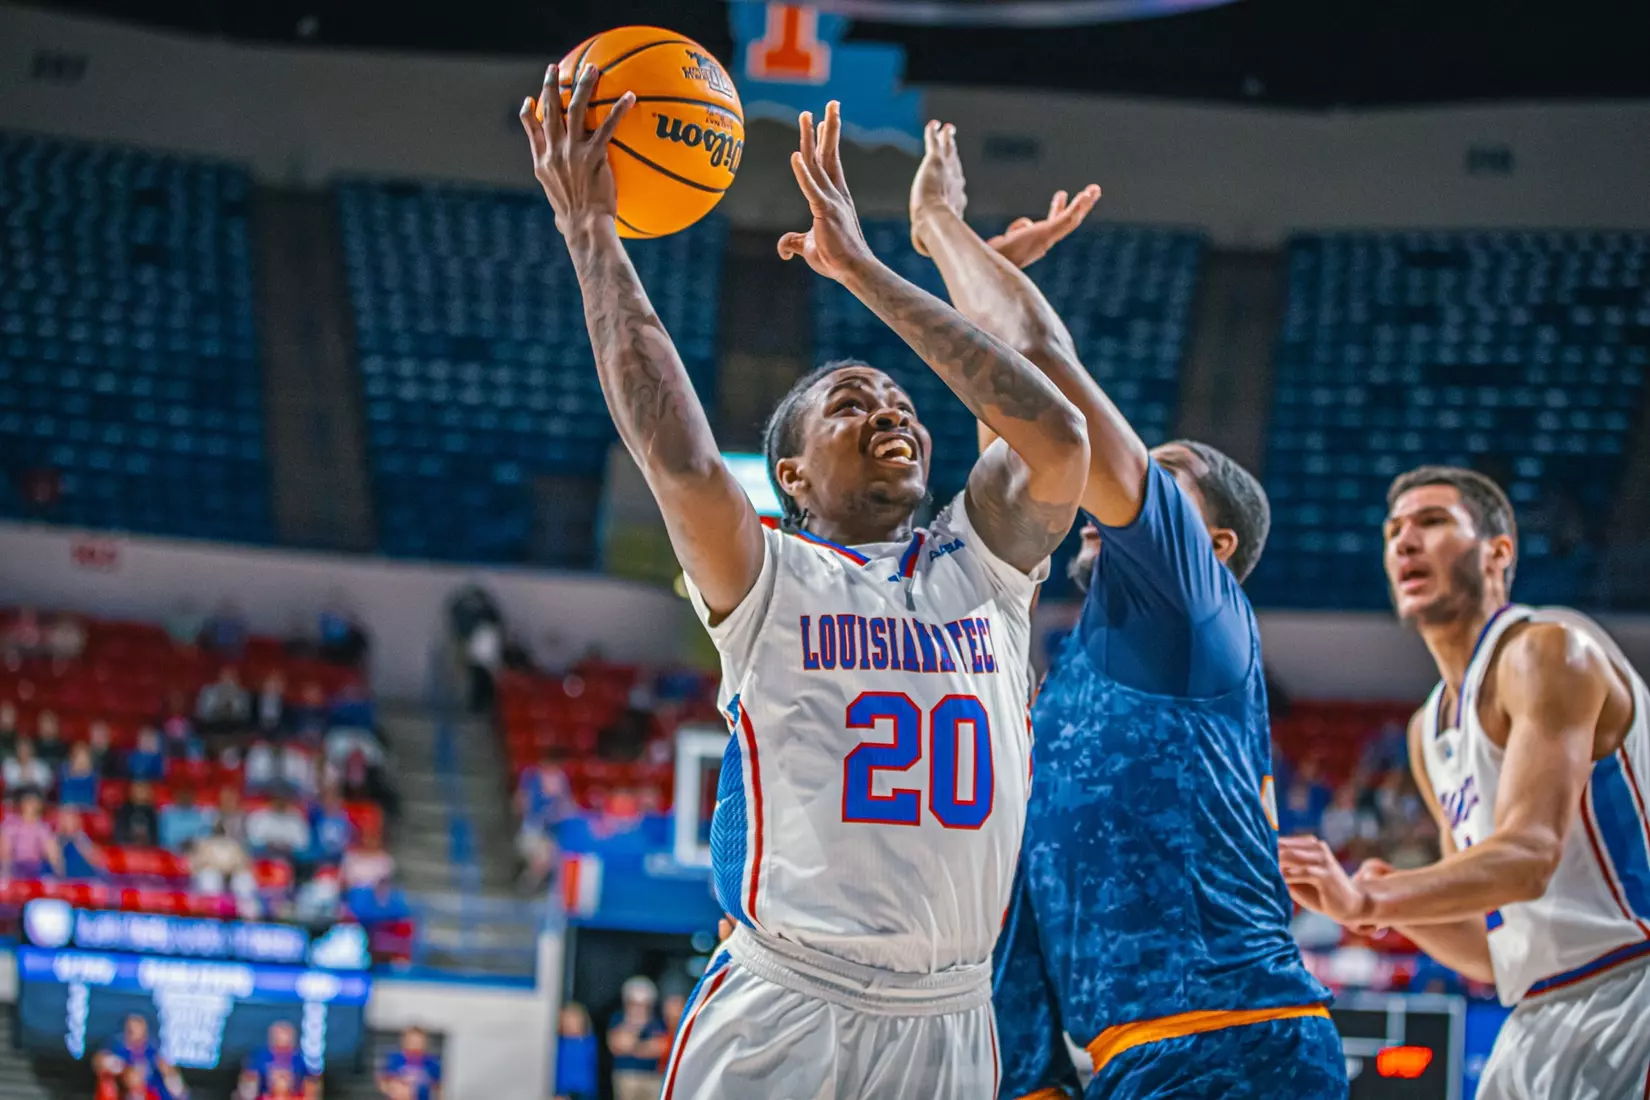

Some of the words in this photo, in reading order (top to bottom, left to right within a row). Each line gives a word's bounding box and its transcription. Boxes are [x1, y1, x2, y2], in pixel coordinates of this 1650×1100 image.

[800, 614, 957, 673] LOUISIANA
[944, 617, 999, 674] TEC
[841, 691, 994, 830] 20
